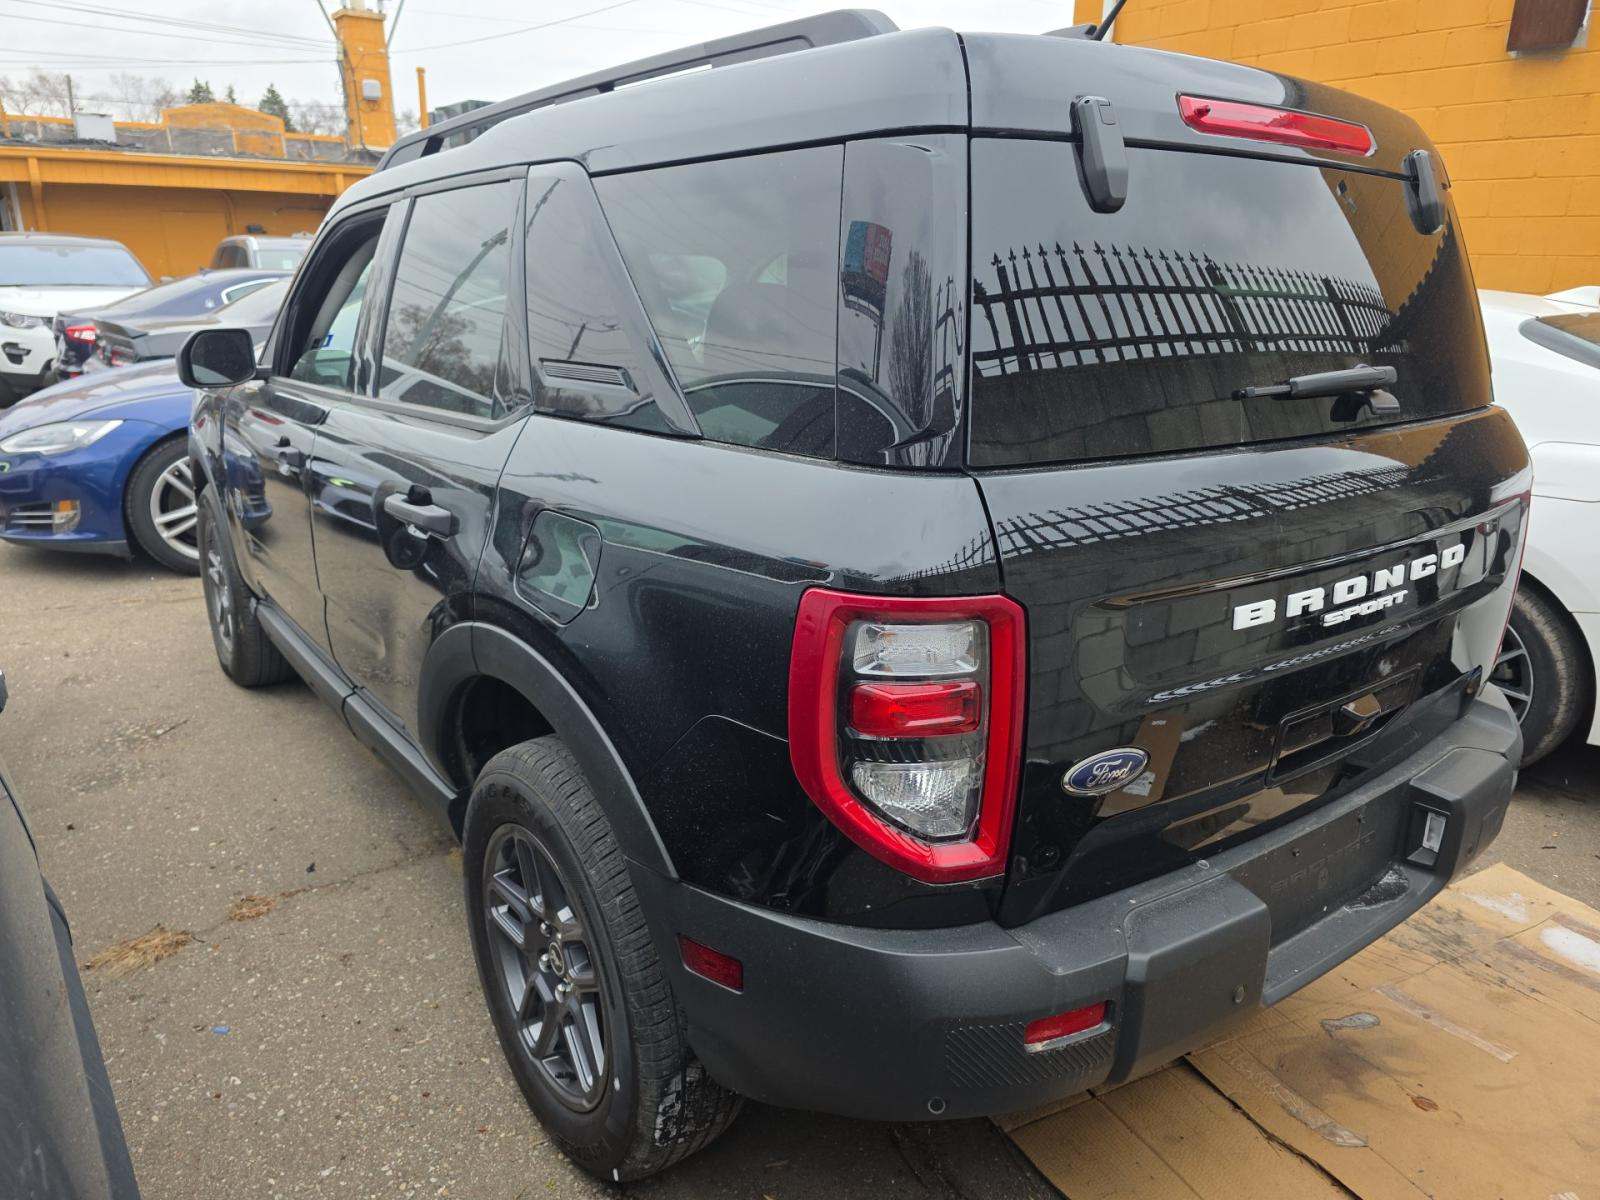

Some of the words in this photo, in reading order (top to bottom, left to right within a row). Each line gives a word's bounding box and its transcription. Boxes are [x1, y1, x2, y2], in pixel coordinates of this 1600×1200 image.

[1233, 544, 1465, 630] BRONCO
[1322, 590, 1408, 627] SPORT
[1086, 759, 1133, 788] Ford
